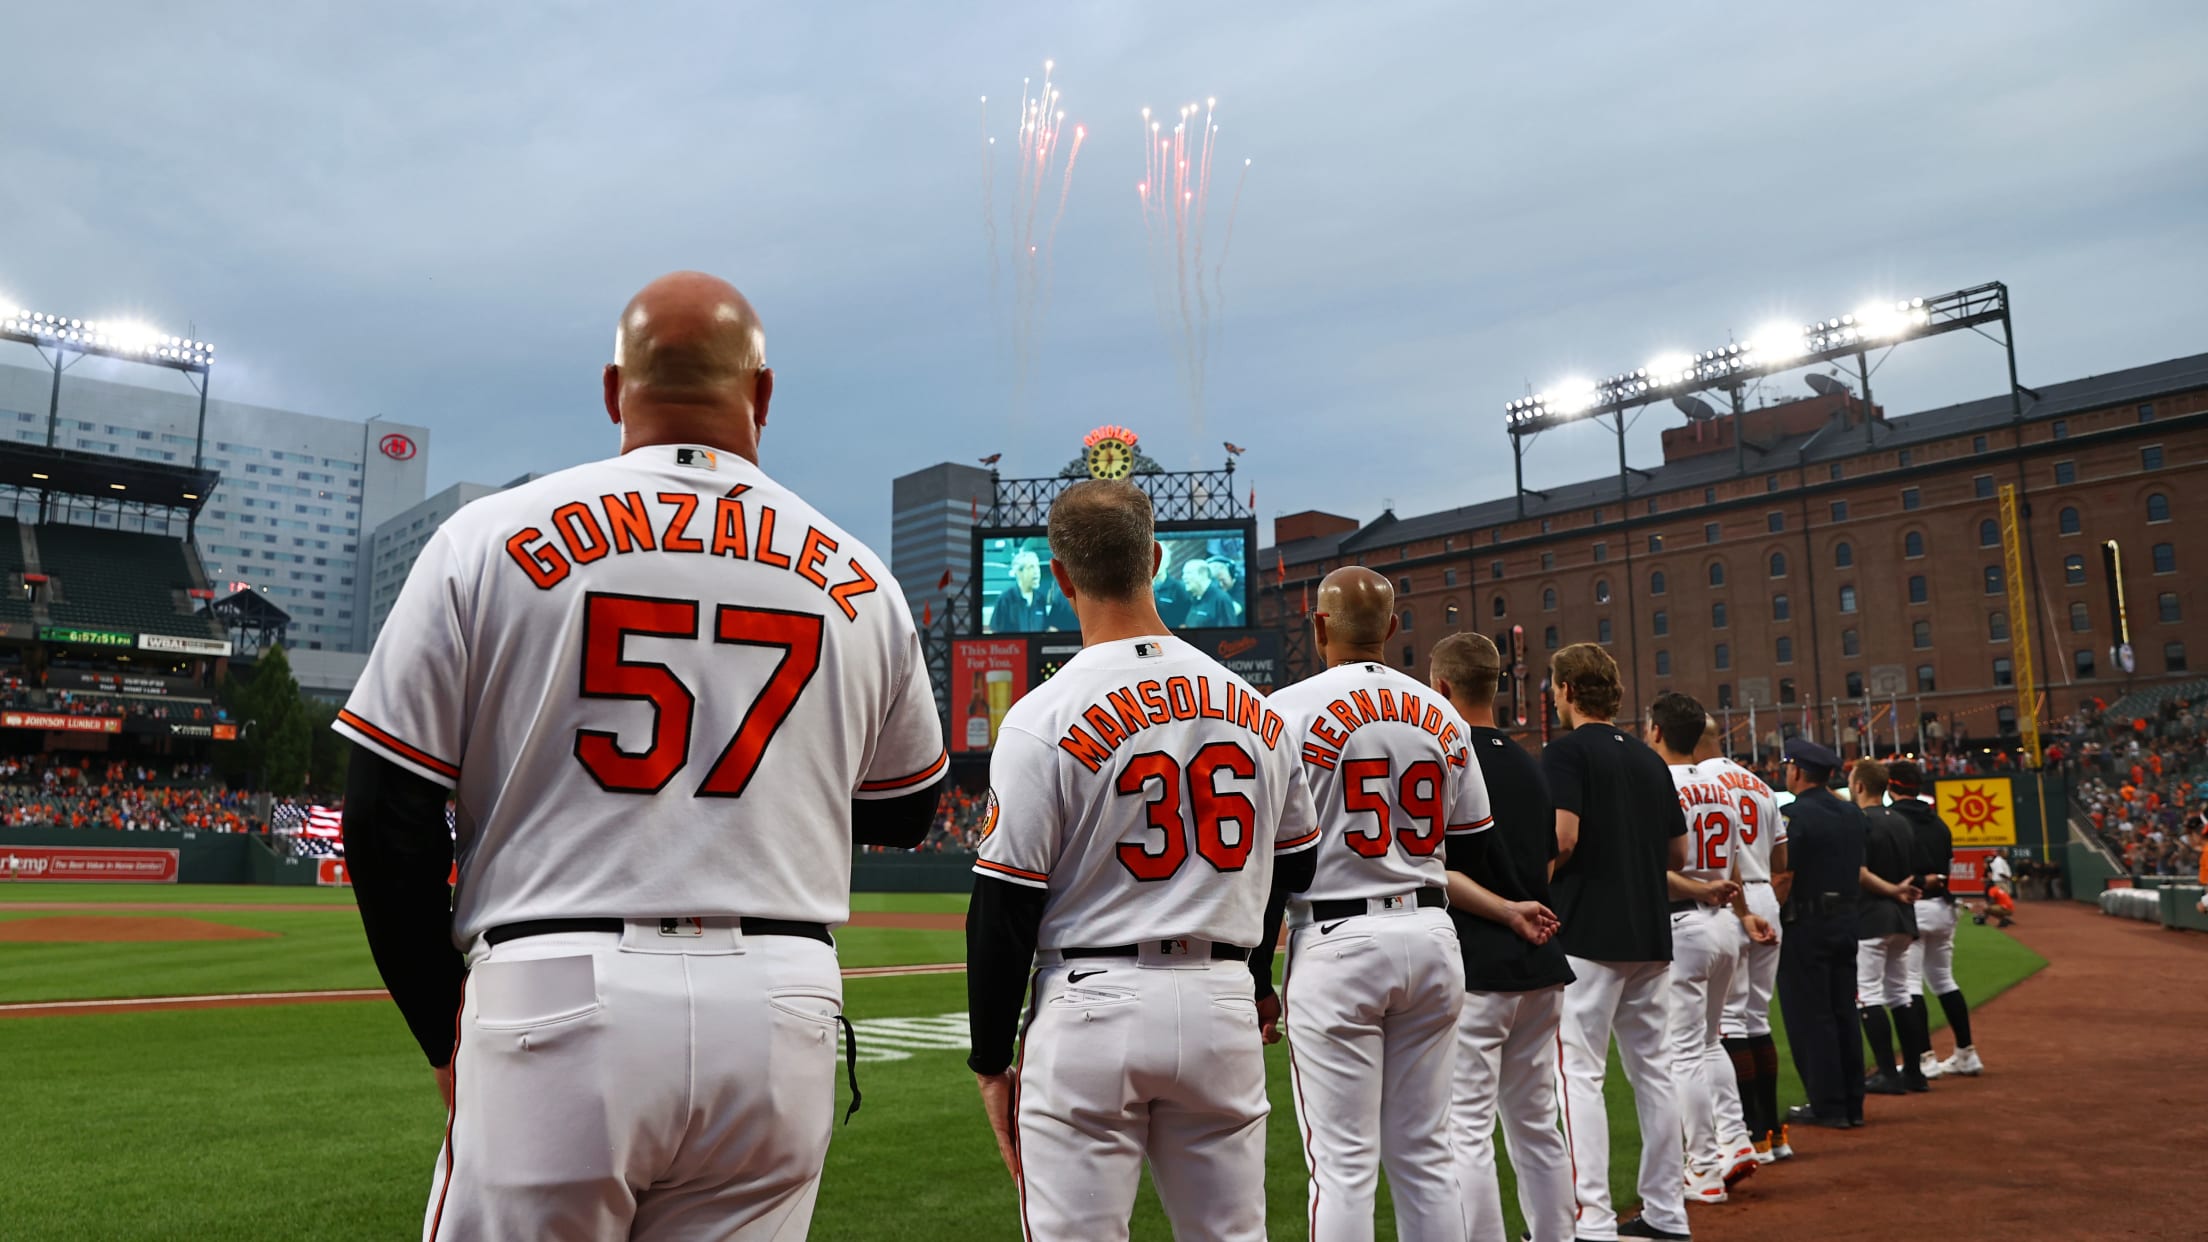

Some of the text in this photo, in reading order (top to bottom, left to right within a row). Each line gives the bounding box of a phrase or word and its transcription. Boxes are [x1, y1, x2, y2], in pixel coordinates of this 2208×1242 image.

[506, 484, 878, 623] GONZÁLEZ
[70, 631, 116, 645] 6:57:51
[961, 644, 1020, 656] This Bud's
[967, 658, 986, 669] For
[1255, 659, 1273, 671] WE
[573, 591, 825, 799] 57
[1058, 675, 1285, 775] MANSOLINO
[1302, 688, 1468, 774] HERNANDEZ
[1116, 741, 1257, 883] 36
[1342, 757, 1446, 859] 59
[1693, 811, 1730, 870] 12
[1739, 795, 1758, 845] 9
